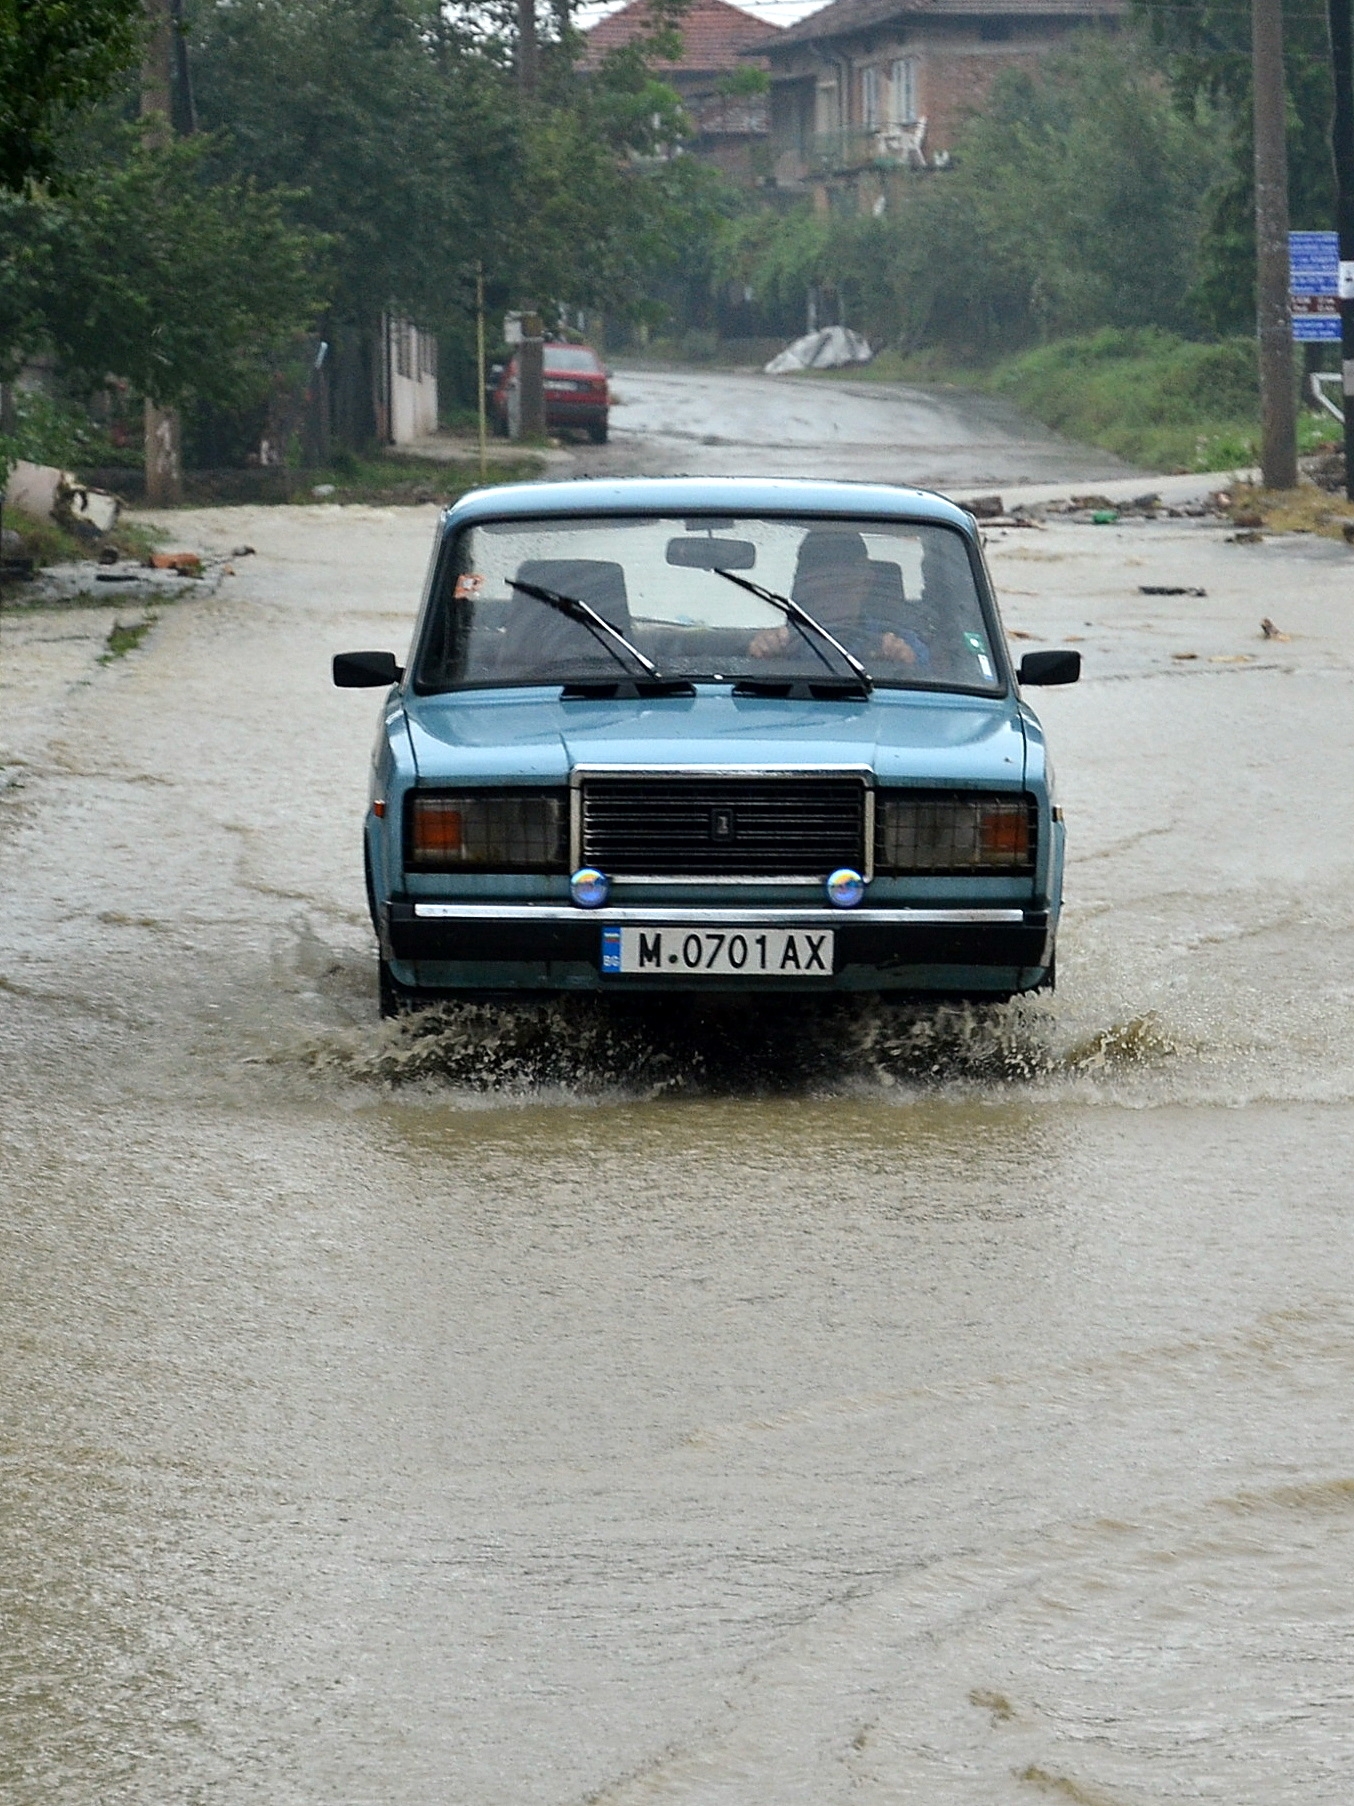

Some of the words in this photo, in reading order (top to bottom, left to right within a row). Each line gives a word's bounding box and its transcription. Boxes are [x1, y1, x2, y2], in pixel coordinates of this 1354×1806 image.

[603, 954, 620, 967] BG
[682, 933, 768, 970] 0701
[779, 934, 827, 970] AX
